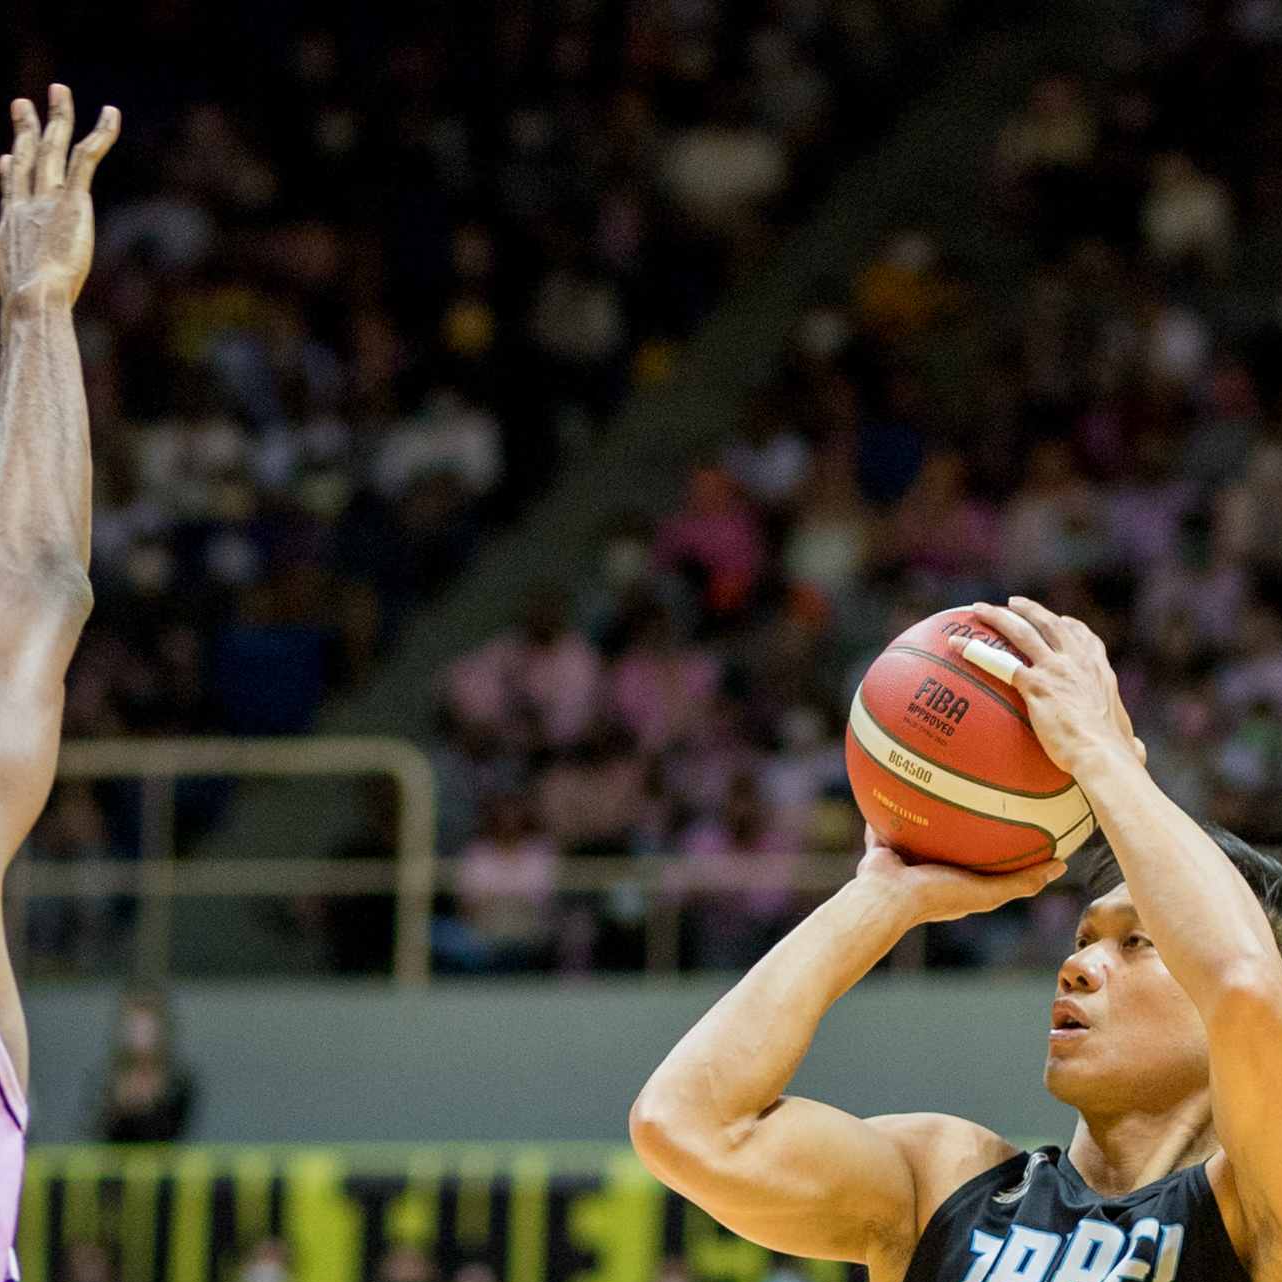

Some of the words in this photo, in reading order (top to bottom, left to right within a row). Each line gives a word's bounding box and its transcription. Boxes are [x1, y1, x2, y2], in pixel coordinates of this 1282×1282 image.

[915, 677, 970, 724] FIBA
[907, 702, 956, 737] APPROVED
[888, 749, 933, 784] BG4500
